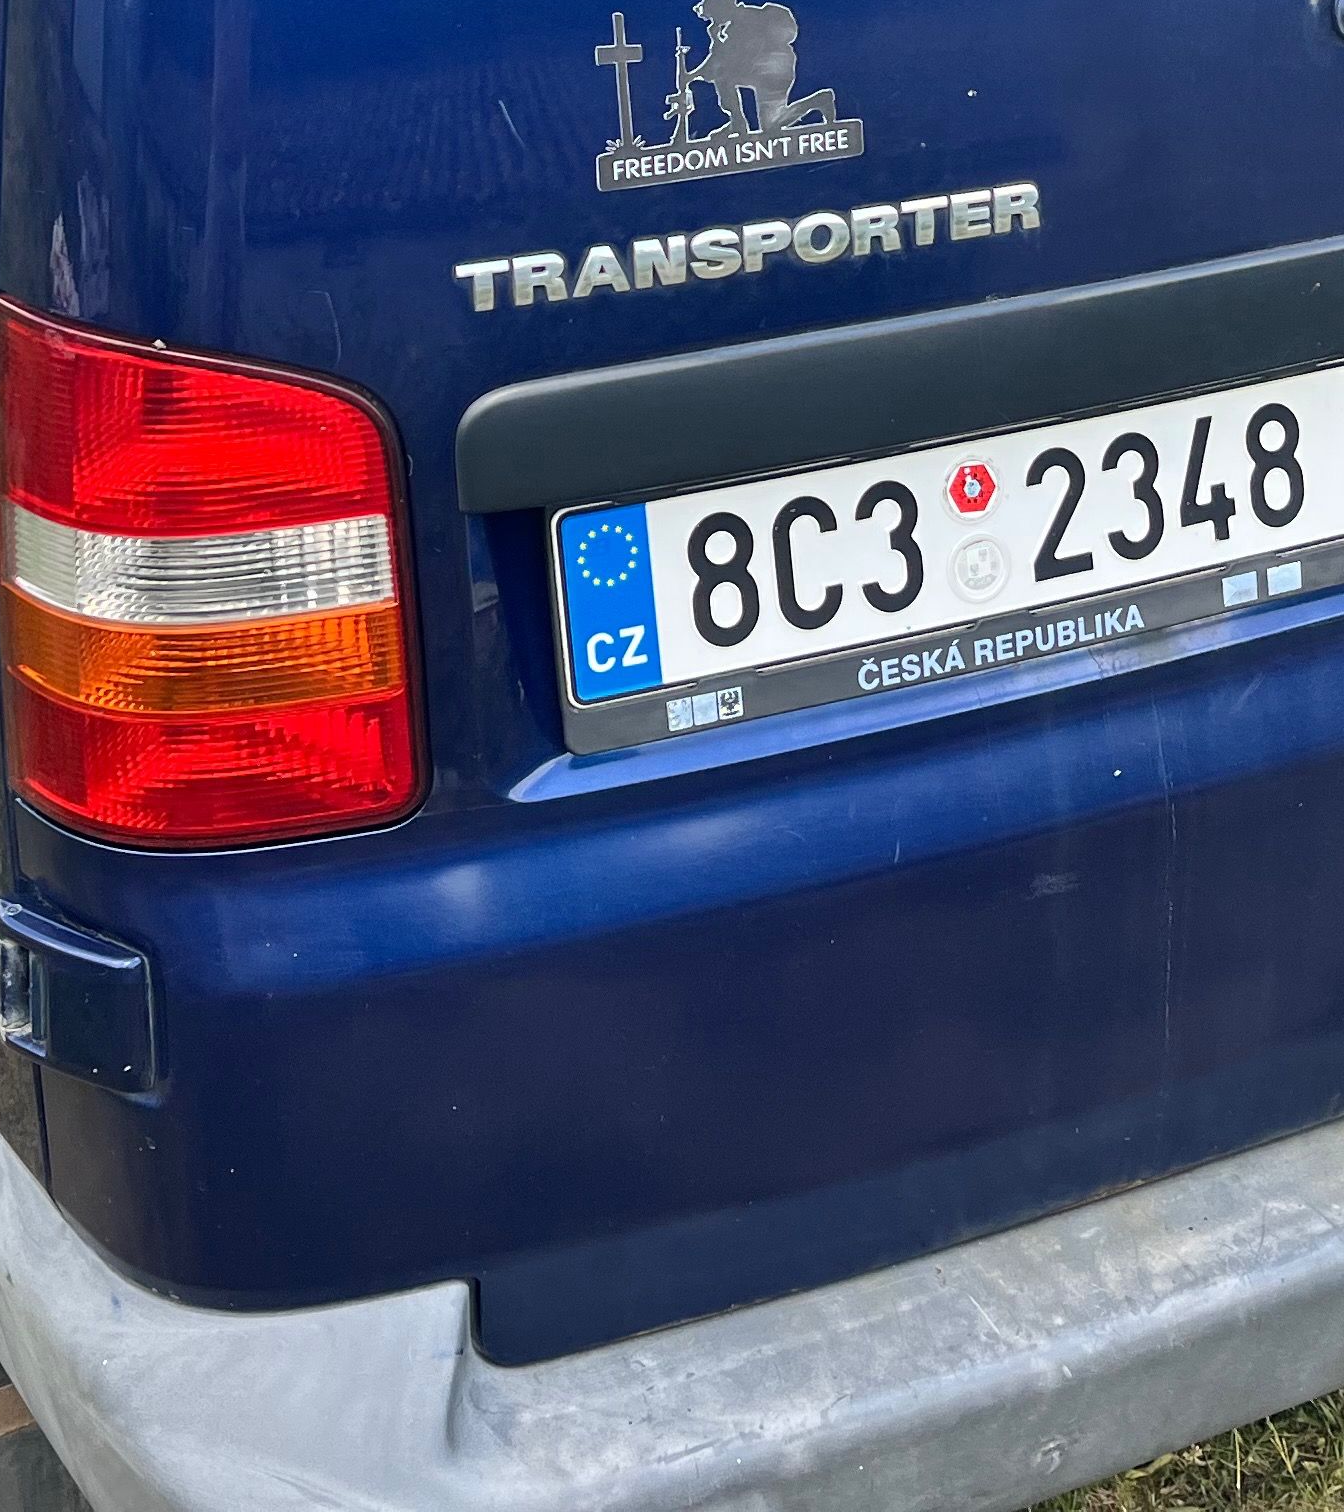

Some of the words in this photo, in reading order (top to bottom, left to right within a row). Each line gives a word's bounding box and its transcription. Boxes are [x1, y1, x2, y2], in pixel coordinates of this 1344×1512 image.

[612, 149, 728, 181] FREEDOM
[735, 137, 791, 164] ISN'T
[798, 129, 849, 155] FREE
[455, 182, 1041, 313] TRANSPORTER
[687, 480, 924, 648] 8C3
[1025, 402, 1305, 583] 2348
[586, 624, 648, 675] CZ
[857, 638, 966, 690] ČESKÁ
[973, 604, 1145, 666] REPUBLIKA
